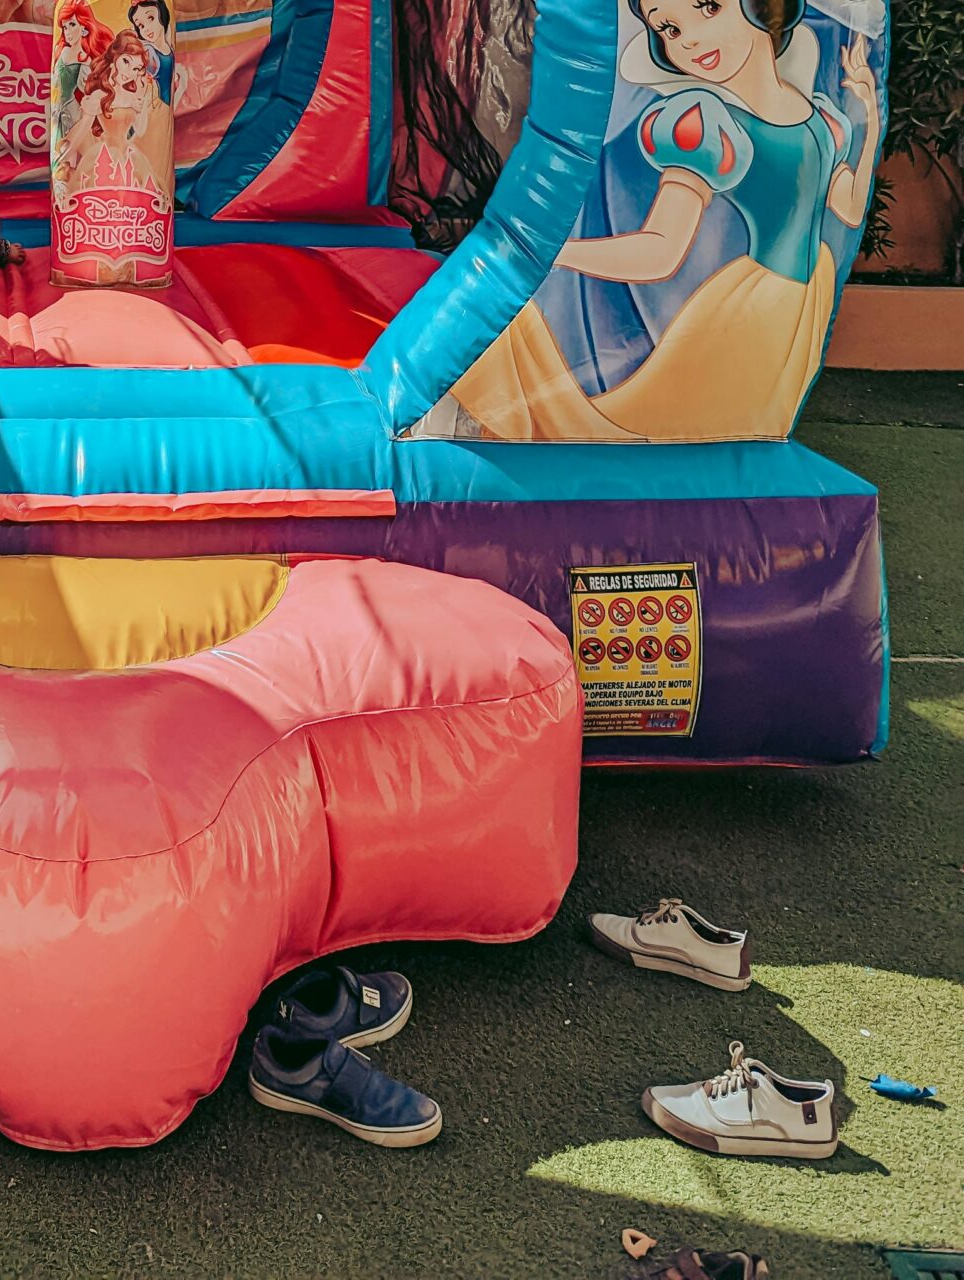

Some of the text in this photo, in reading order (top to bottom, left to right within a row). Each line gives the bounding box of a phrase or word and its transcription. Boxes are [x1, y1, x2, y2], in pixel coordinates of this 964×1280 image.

[63, 219, 164, 257] PRINCESS
[589, 573, 678, 590] REGLAS DE SEGURIDAD
[625, 681, 656, 689] ALEJADO
[657, 680, 667, 688] DE
[668, 680, 692, 688] MOTOR
[590, 691, 617, 699] OPERAR
[618, 690, 643, 698] EQUIPO
[624, 699, 655, 707] SEVERAS
[656, 698, 669, 706] DEL
[670, 698, 691, 706] CLIMA
